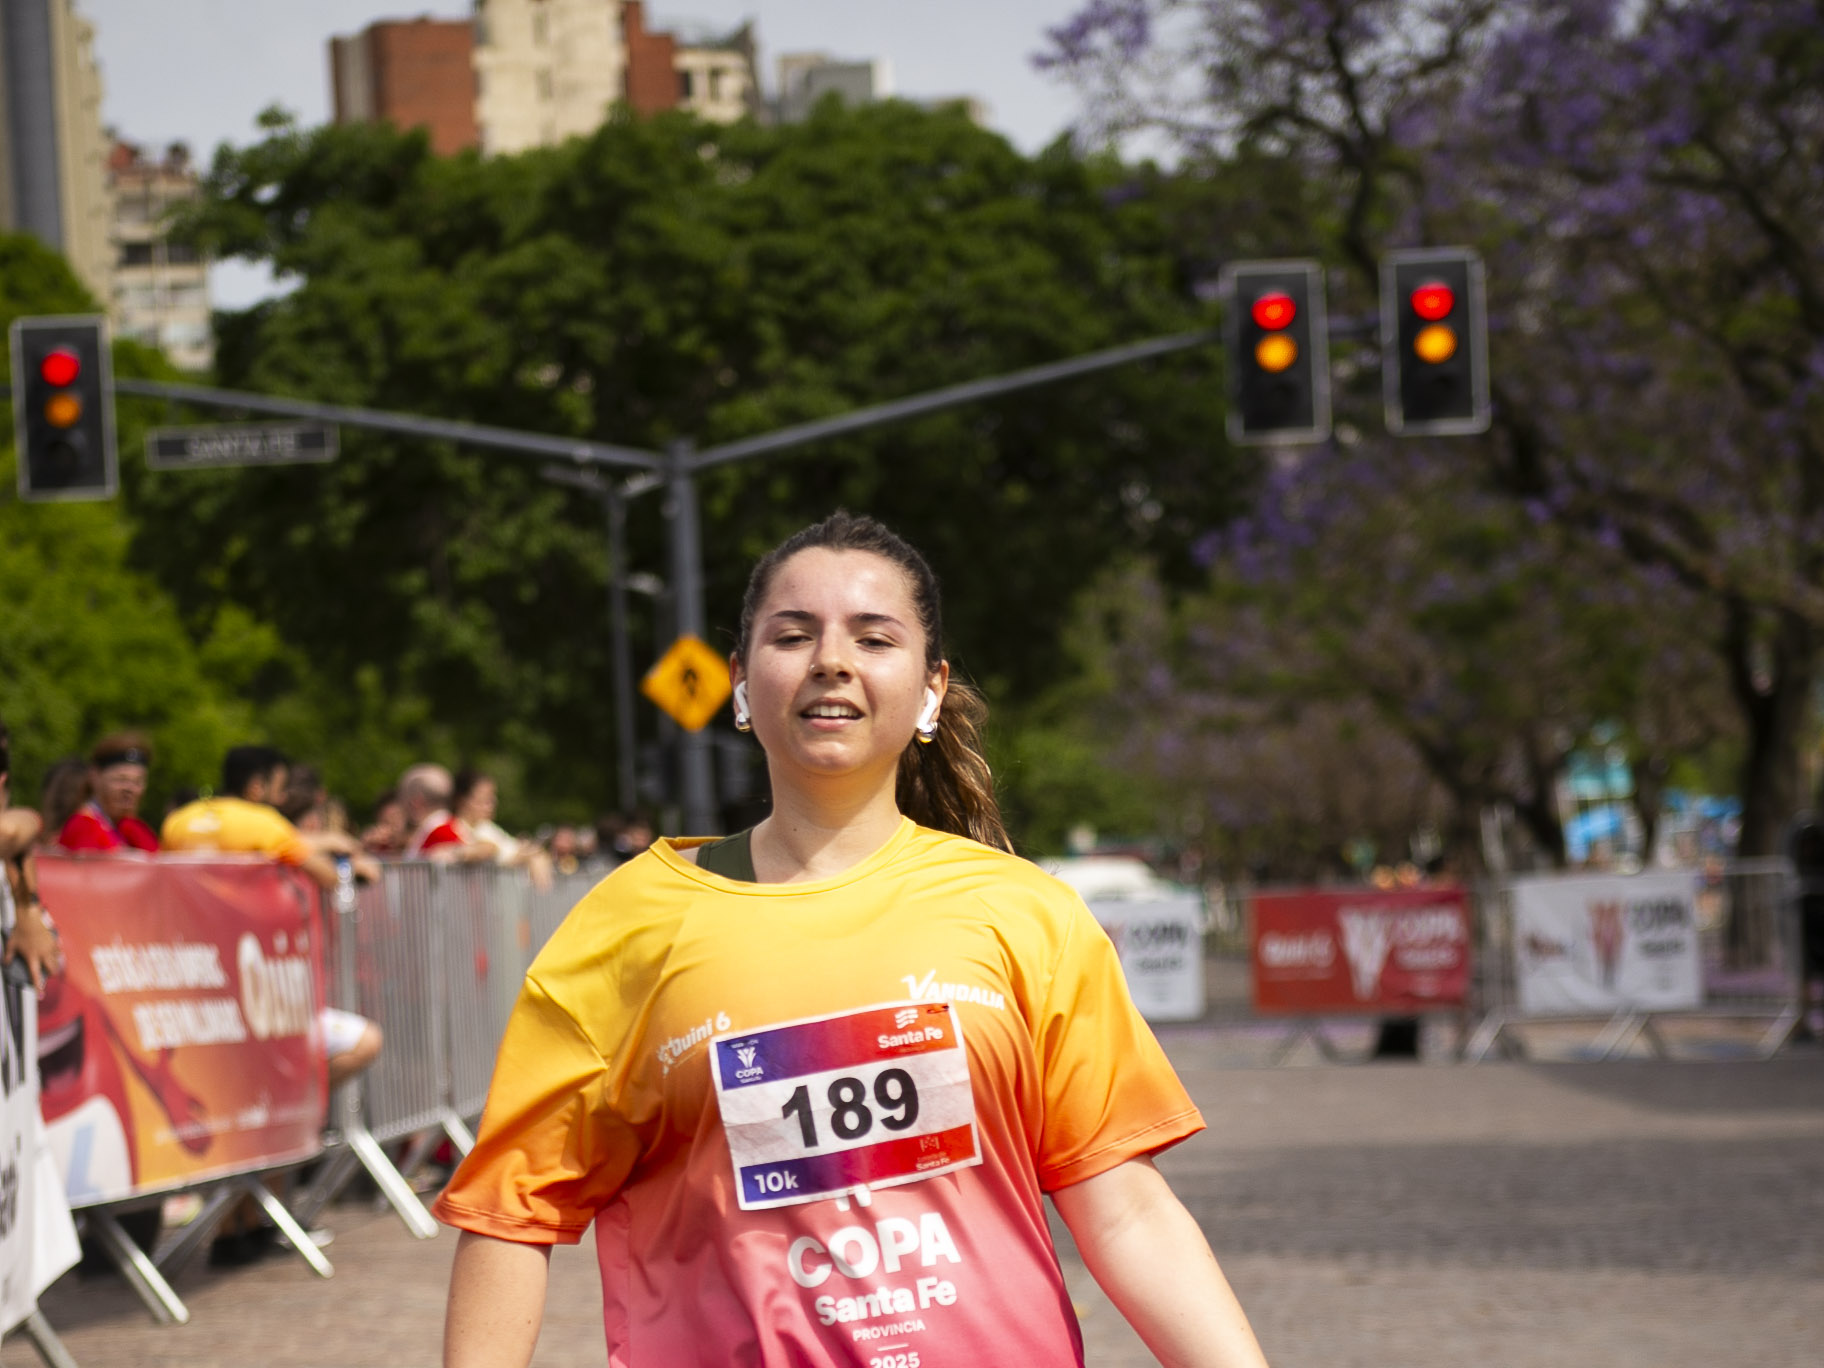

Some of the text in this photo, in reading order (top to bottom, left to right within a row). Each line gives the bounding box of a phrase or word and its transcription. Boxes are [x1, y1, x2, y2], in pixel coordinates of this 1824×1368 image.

[901, 969, 1005, 1011] VANDALIA
[715, 1011, 731, 1032] 6
[877, 1030, 924, 1049] Santa
[923, 1026, 944, 1041] Fe
[735, 1066, 764, 1079] COPA
[781, 1068, 920, 1149] 189
[753, 1169, 800, 1195] 10k
[787, 1212, 962, 1289] COPA
[815, 1276, 958, 1326] Santa Fe
[852, 1318, 927, 1343] PROVINCIA
